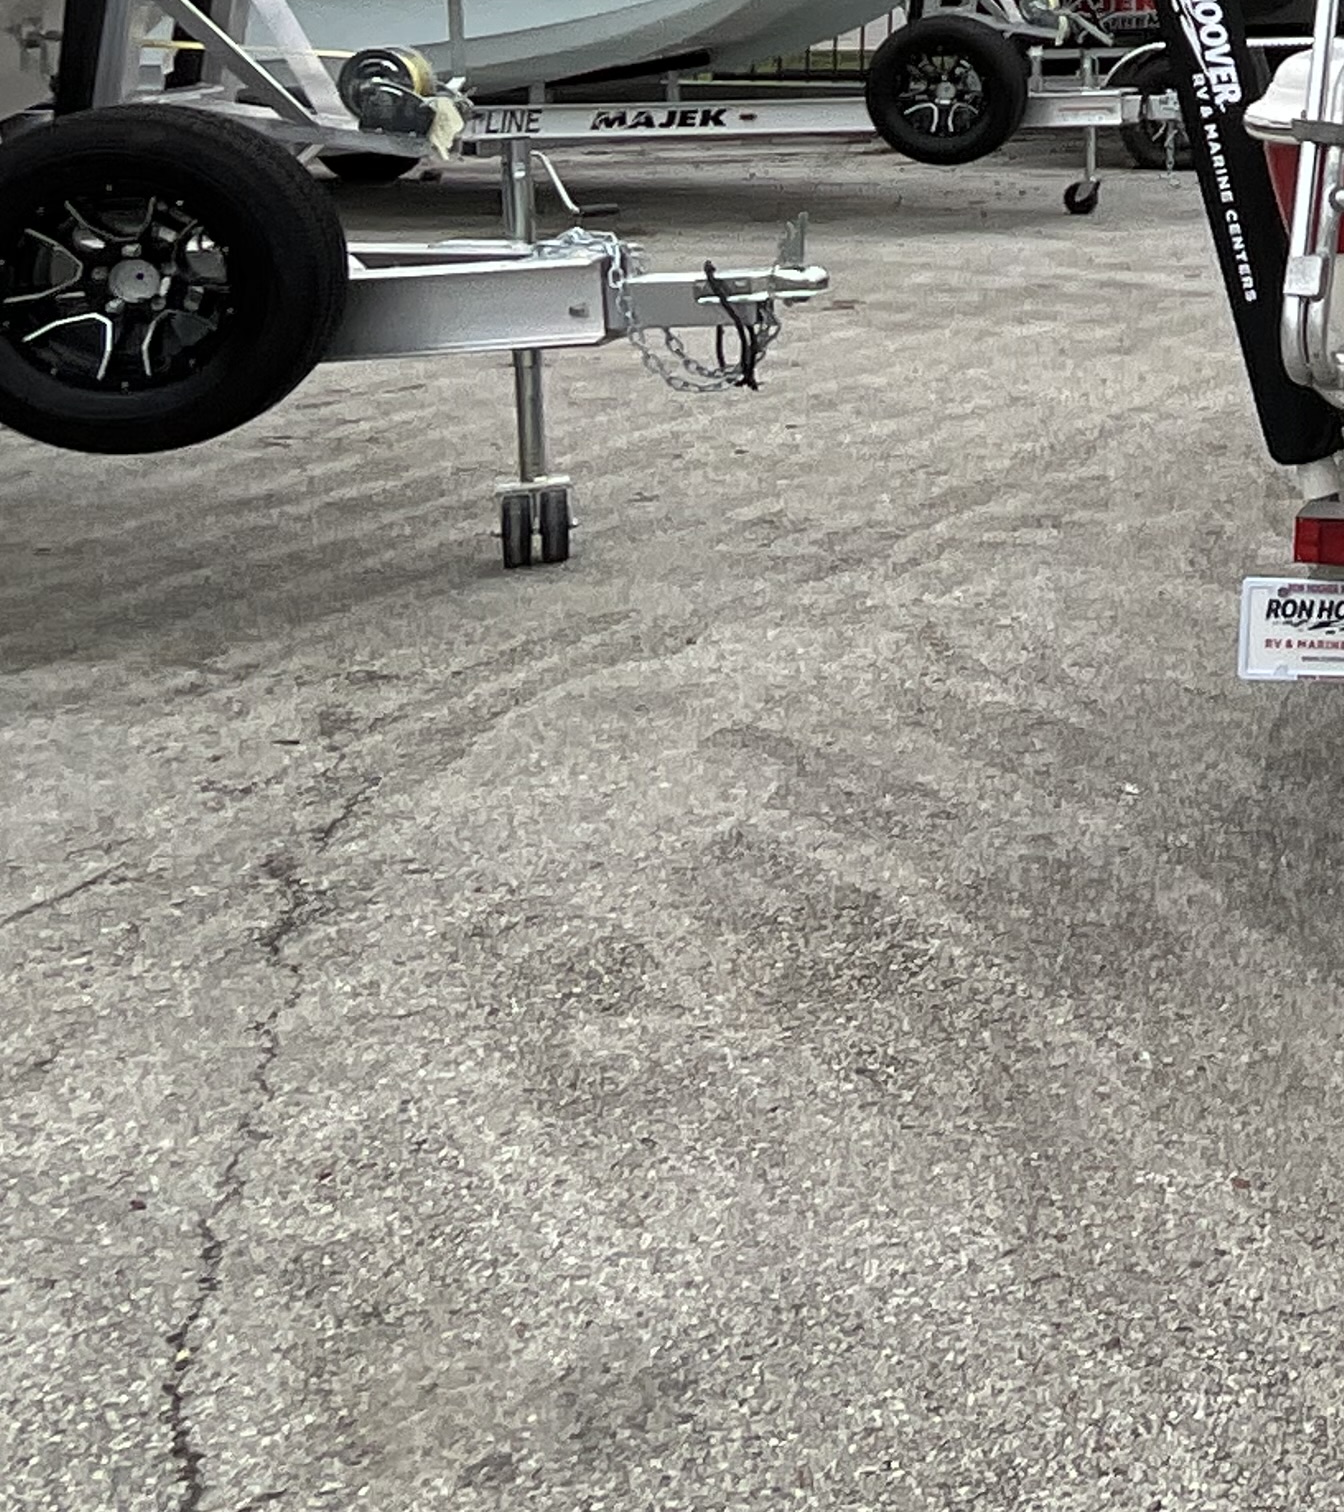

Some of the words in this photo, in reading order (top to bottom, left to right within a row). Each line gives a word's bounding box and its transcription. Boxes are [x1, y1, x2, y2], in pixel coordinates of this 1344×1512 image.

[469, 109, 543, 134] TLINE
[589, 108, 728, 131] MAJEK
[1192, 72, 1210, 101] RV
[1203, 123, 1235, 204] MARINE
[1225, 208, 1258, 303] CENTERS
[1265, 598, 1315, 620] RON
[1264, 638, 1283, 649] RV
